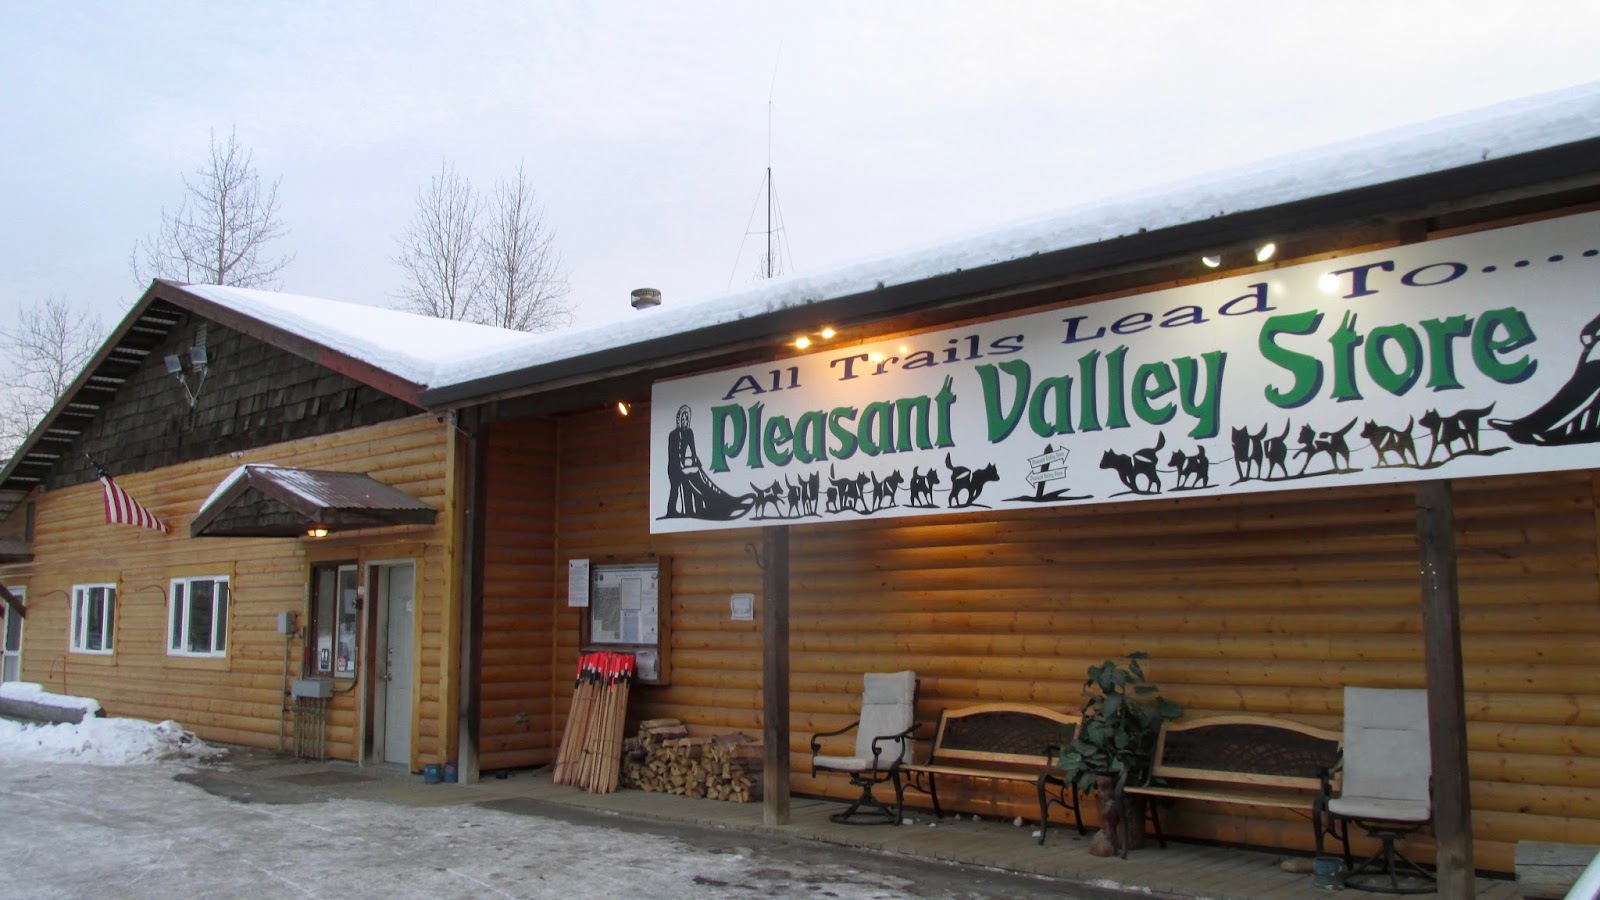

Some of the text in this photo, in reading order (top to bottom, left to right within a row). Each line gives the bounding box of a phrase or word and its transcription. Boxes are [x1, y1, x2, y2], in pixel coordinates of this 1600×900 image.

[709, 306, 1538, 473] Pleasant Valley Store
[722, 366, 802, 400] All
[830, 334, 1024, 381] Trails
[1061, 282, 1277, 344] Lead
